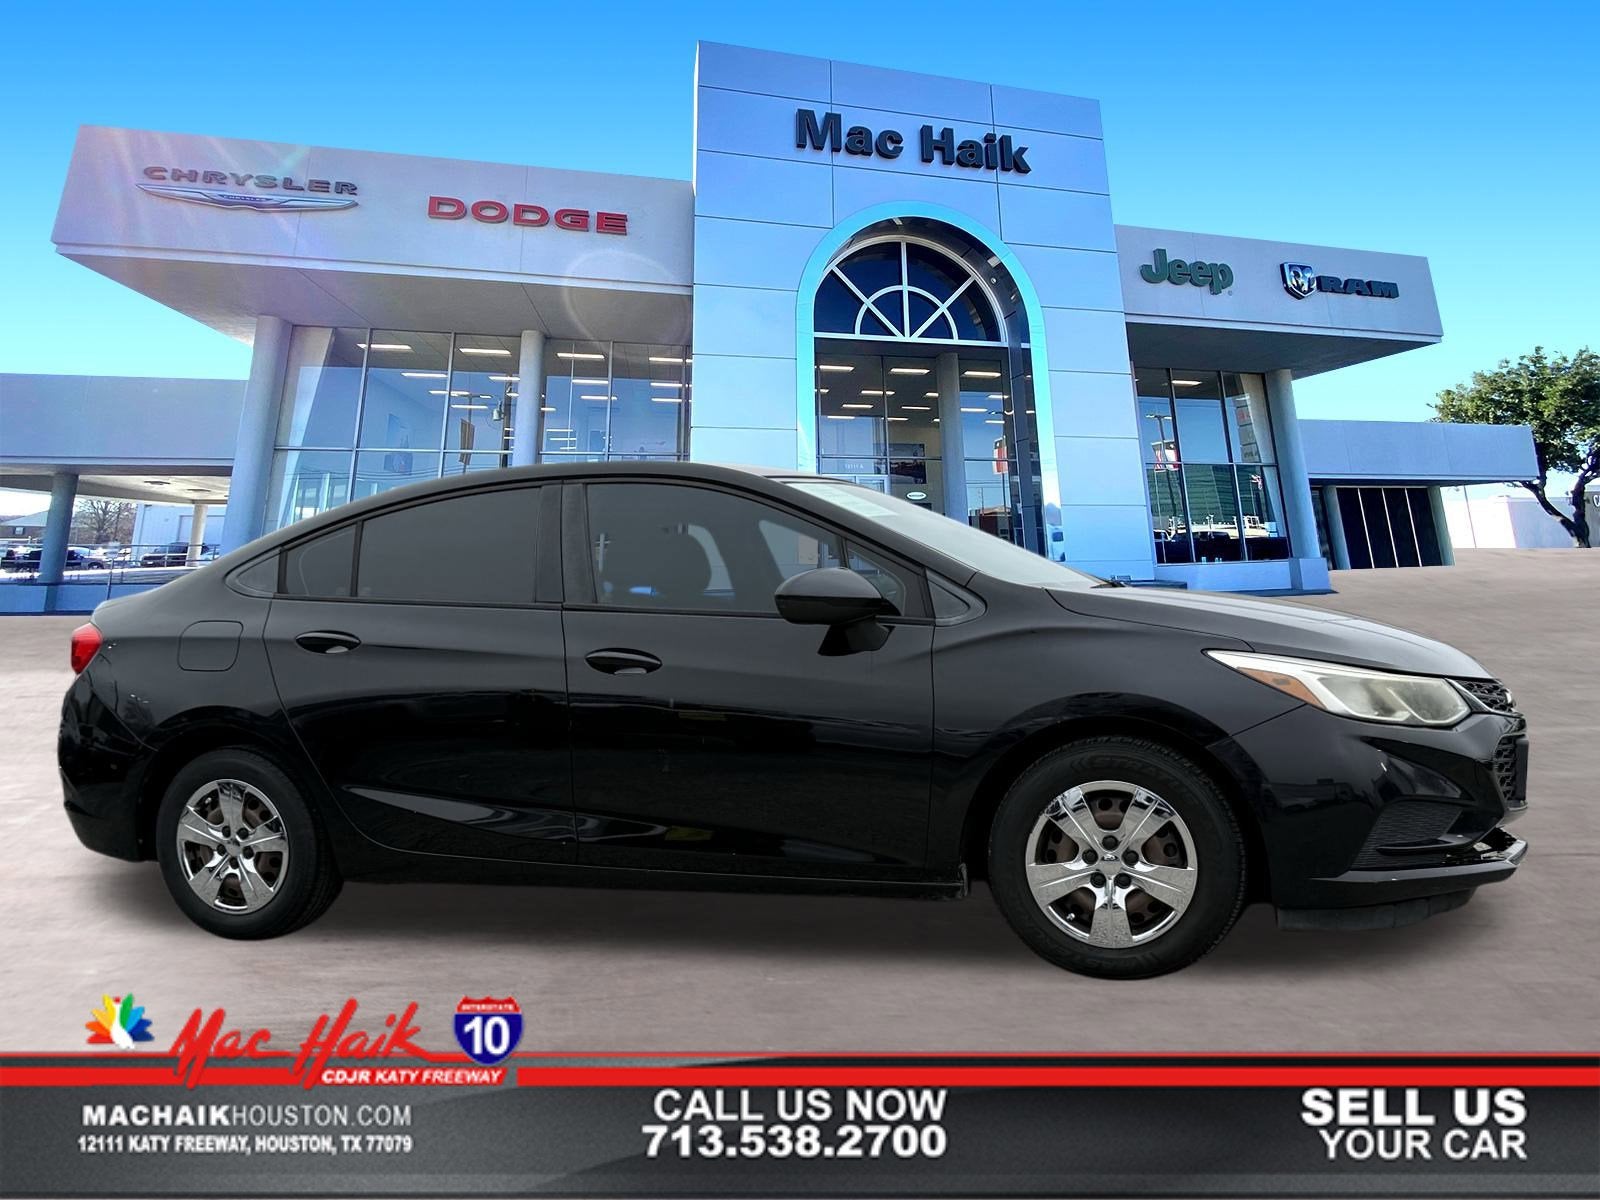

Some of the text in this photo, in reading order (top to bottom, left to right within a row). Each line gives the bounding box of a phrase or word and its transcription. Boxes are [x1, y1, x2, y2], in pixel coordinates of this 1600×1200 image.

[795, 108, 1032, 174] Mac Haik
[143, 166, 358, 196] CHRYSLER
[428, 195, 628, 236] DODGE
[1140, 248, 1234, 295] Jeep
[1316, 275, 1400, 299] RAM
